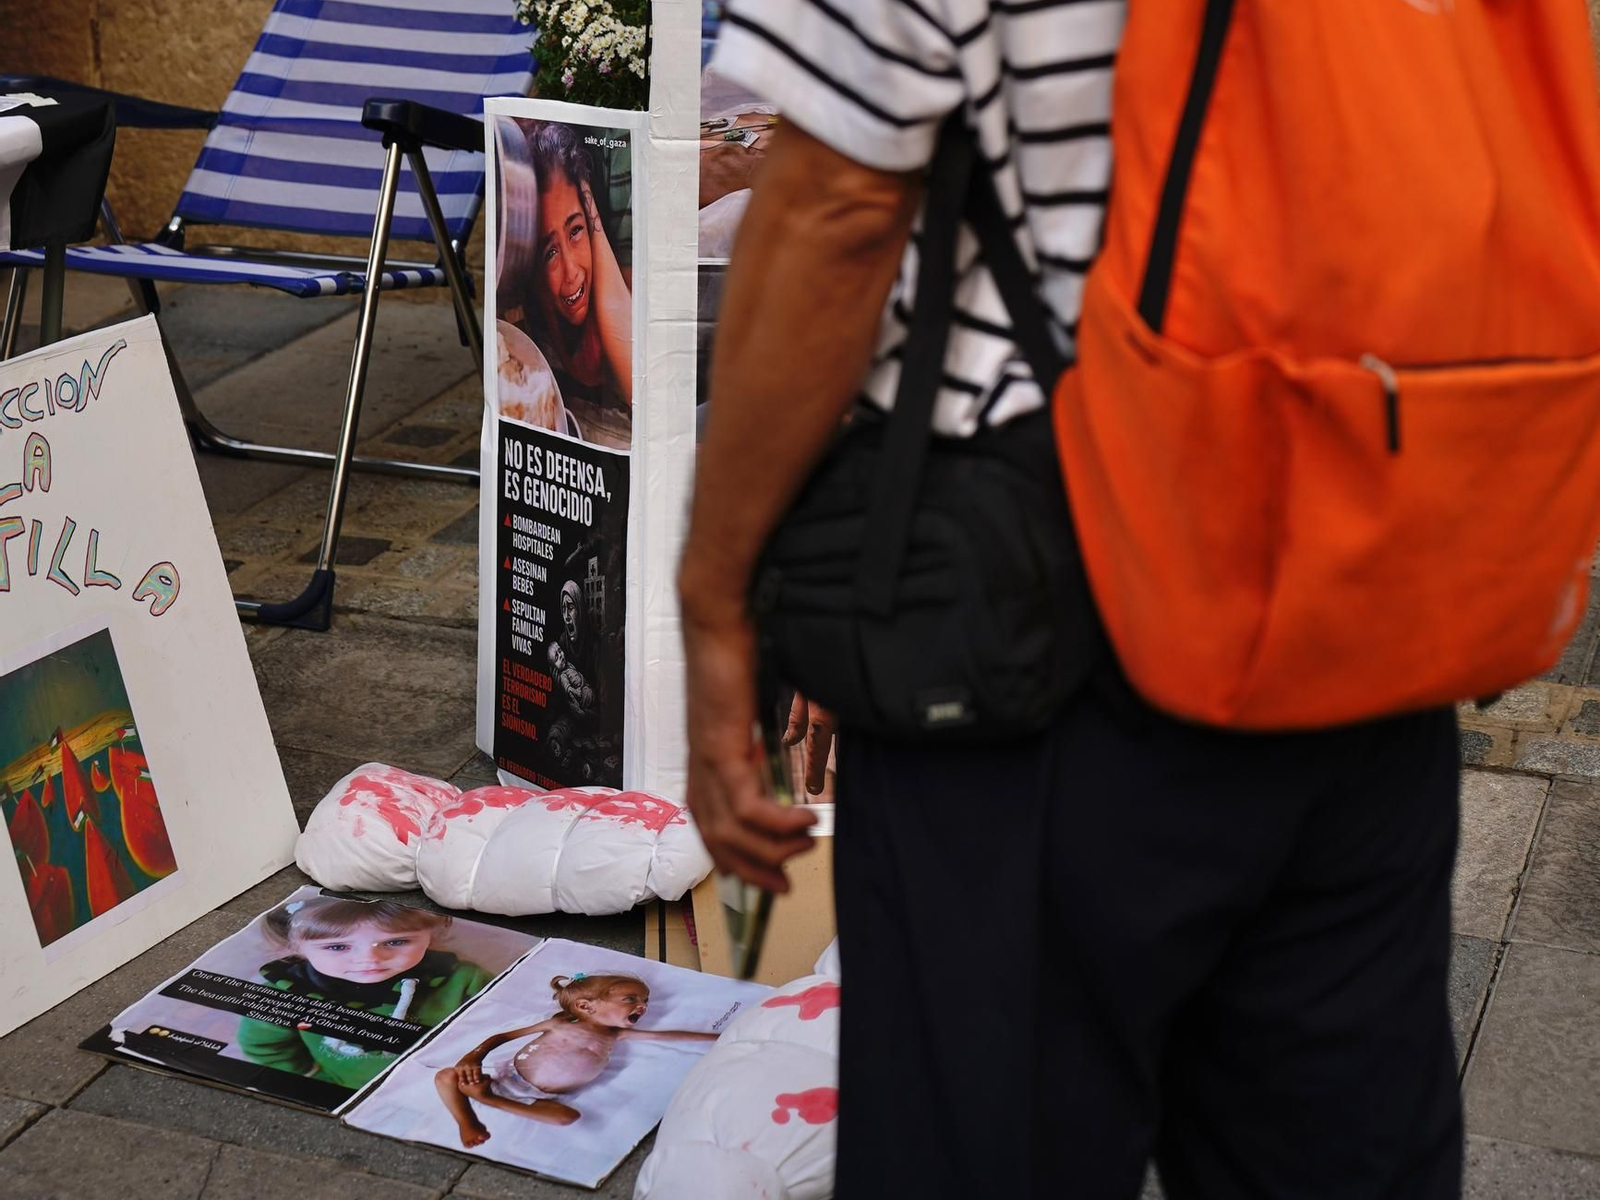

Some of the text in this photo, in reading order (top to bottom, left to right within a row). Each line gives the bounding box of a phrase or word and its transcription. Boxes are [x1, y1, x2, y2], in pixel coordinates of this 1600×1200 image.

[584, 135, 627, 149] sake_of_gaza
[0, 338, 127, 432] CCION
[504, 437, 611, 503] NO ES DEFENSA,
[504, 469, 593, 527] ES GENOCIDIO
[512, 514, 561, 545] BOMBARDEAN
[512, 532, 554, 560] HOSPITALES
[512, 557, 547, 583] ASESINAN
[512, 575, 534, 596] BEBÉS
[511, 598, 546, 625] SEPULTAN
[512, 616, 544, 642] FAMILIAS
[511, 634, 532, 656] VIVAS
[503, 658, 553, 692] EL VERDADERO
[502, 676, 547, 708] TERRORISMO
[502, 693, 520, 715] ES EL
[502, 711, 539, 741] SIONISMO.
[178, 984, 198, 994] The
[198, 988, 241, 1005] beautiful
[243, 1001, 269, 1011] child
[268, 1007, 300, 1019] Sewar
[357, 1029, 383, 1041] from
[384, 1036, 400, 1044] Al-
[192, 970, 423, 1032] One of the victims of the daily bombings against
[242, 992, 260, 1000] our
[259, 996, 294, 1009] people
[307, 1007, 340, 1021] #Gaza
